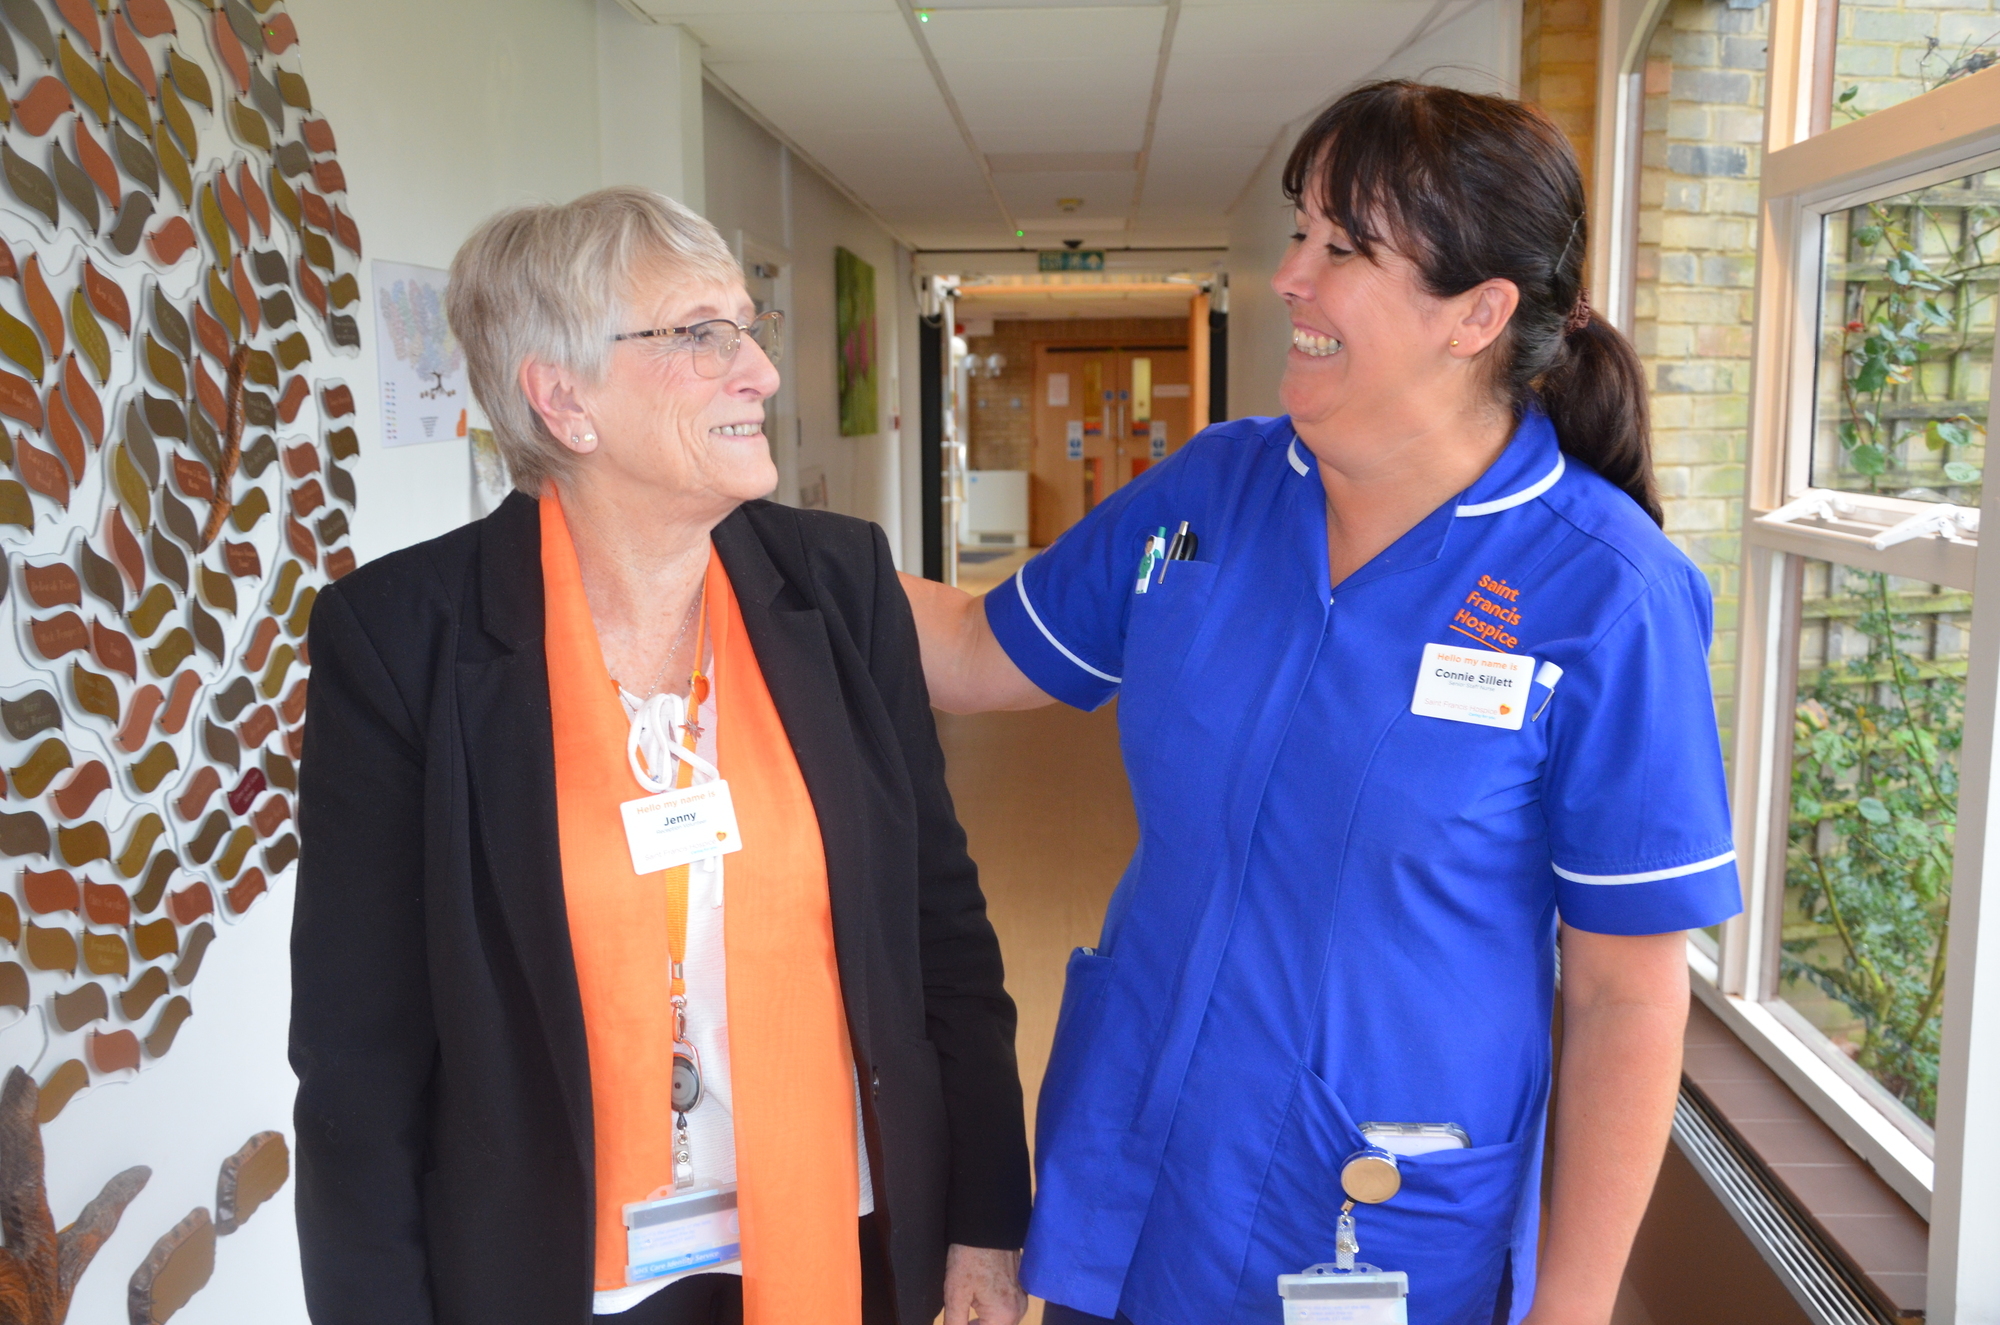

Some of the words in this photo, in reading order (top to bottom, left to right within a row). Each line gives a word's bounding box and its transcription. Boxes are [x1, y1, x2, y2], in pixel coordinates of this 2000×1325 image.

[1477, 574, 1520, 602] Saint
[1465, 591, 1522, 626] Francis
[1454, 608, 1518, 648] Hospice
[1437, 653, 1462, 664] Hello
[1464, 658, 1478, 666] my
[1481, 661, 1508, 670] name
[1509, 662, 1518, 671] is
[1435, 668, 1475, 682] Connie
[1478, 674, 1514, 688] Sillett
[1466, 682, 1479, 690] Staff
[1480, 684, 1496, 692] Nurse
[1424, 697, 1442, 707] Saint
[1443, 700, 1468, 711] Francis
[1469, 704, 1498, 715] Hospice
[637, 804, 661, 815] Hello
[664, 800, 678, 808] my
[681, 794, 705, 804] name
[664, 812, 697, 826] Jenny
[650, 1262, 666, 1272] Care
[695, 1251, 720, 1261] Service
